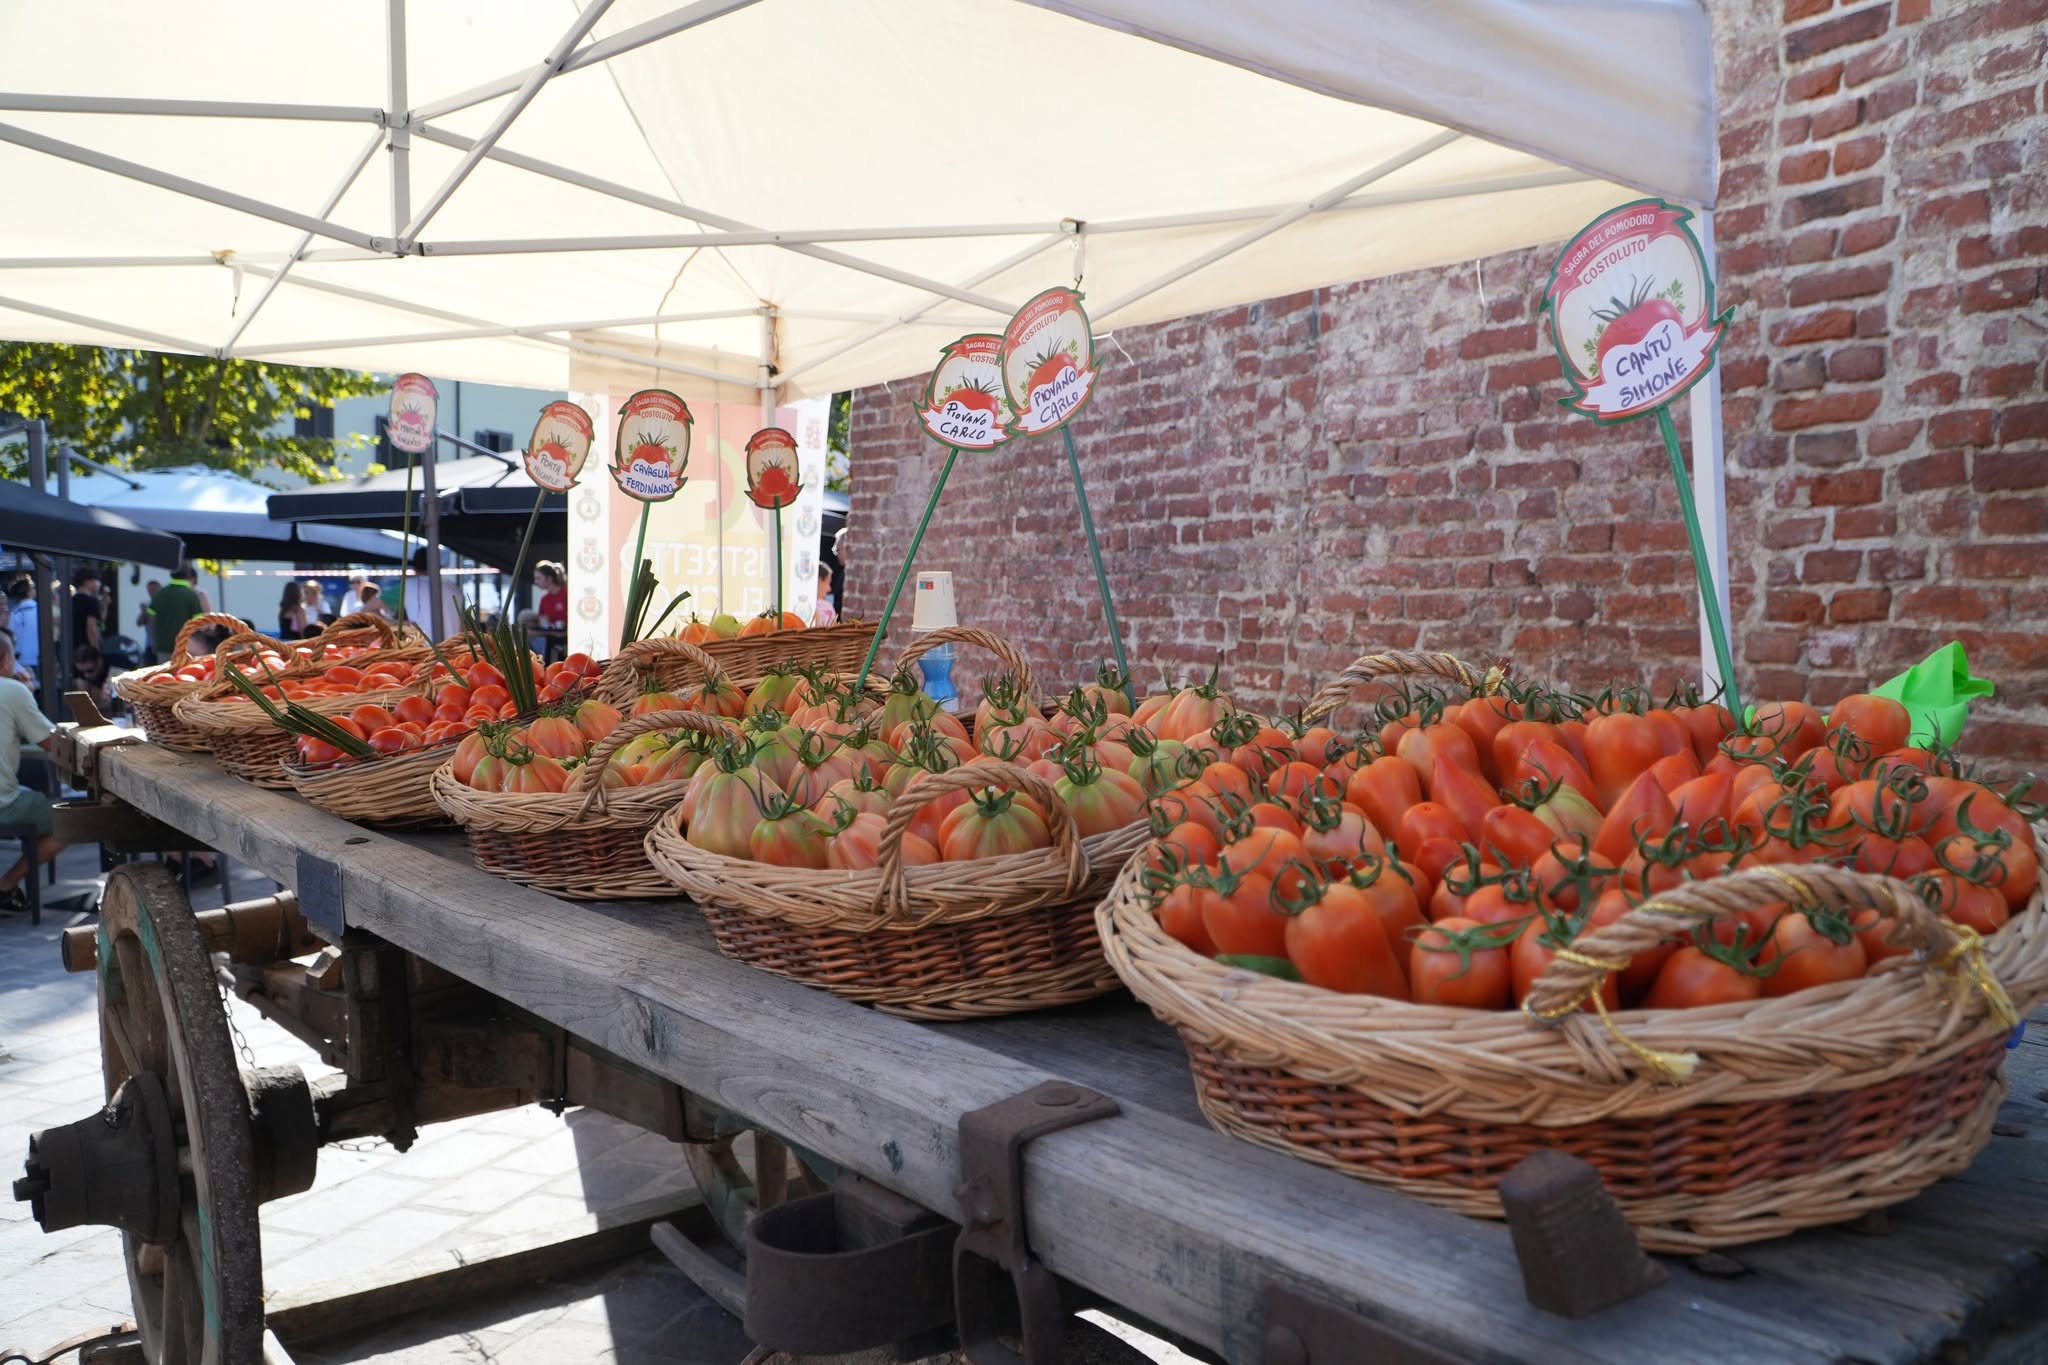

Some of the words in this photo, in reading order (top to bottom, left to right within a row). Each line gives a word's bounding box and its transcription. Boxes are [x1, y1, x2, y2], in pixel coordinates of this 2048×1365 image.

[1564, 246, 1590, 277] SAGRA
[1589, 235, 1606, 250] DEL
[1604, 213, 1655, 240] POMODORO
[1583, 239, 1646, 285] COSTOLUTO
[1010, 319, 1026, 340] SAGRA
[1024, 311, 1034, 322] DEL
[1034, 296, 1064, 314] POMODORO
[1020, 313, 1058, 345] COSTOLUTO
[965, 341, 985, 350] SAGRA
[985, 342, 997, 350] DEL
[1619, 357, 1688, 408] SIMONE
[641, 411, 673, 422] COSTOLUTO
[946, 402, 987, 426] PIOVANO
[1040, 391, 1079, 424] CARLO
[939, 421, 986, 440] CARLO
[533, 466, 560, 485] MICHELE
[540, 453, 561, 476] PORTA
[626, 477, 674, 494] FERDINANDO
